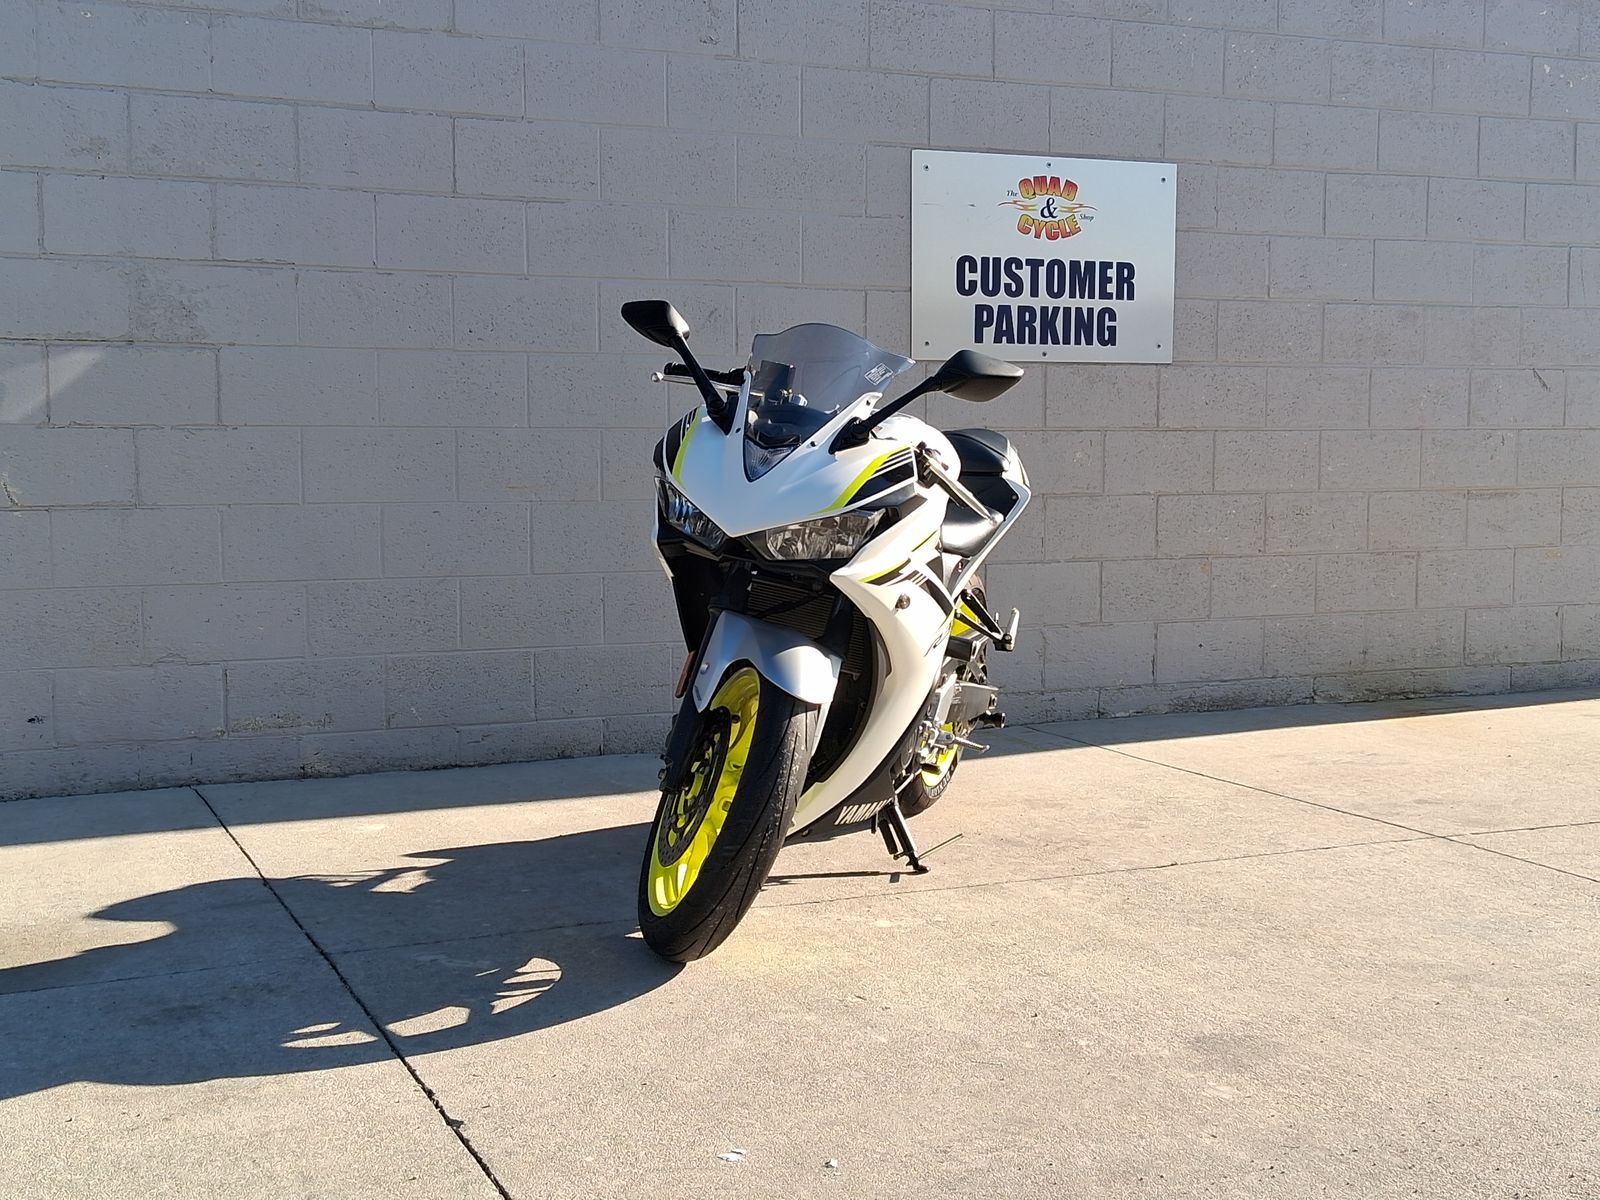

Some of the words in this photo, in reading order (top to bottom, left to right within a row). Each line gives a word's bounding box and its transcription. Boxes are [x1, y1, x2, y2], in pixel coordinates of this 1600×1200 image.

[1018, 175, 1079, 202] QUAD
[1040, 197, 1058, 219] &
[1016, 213, 1082, 241] CYCLE
[1079, 213, 1095, 223] Shop
[956, 254, 1136, 301] CUSTOMER
[974, 303, 1118, 347] PARKING
